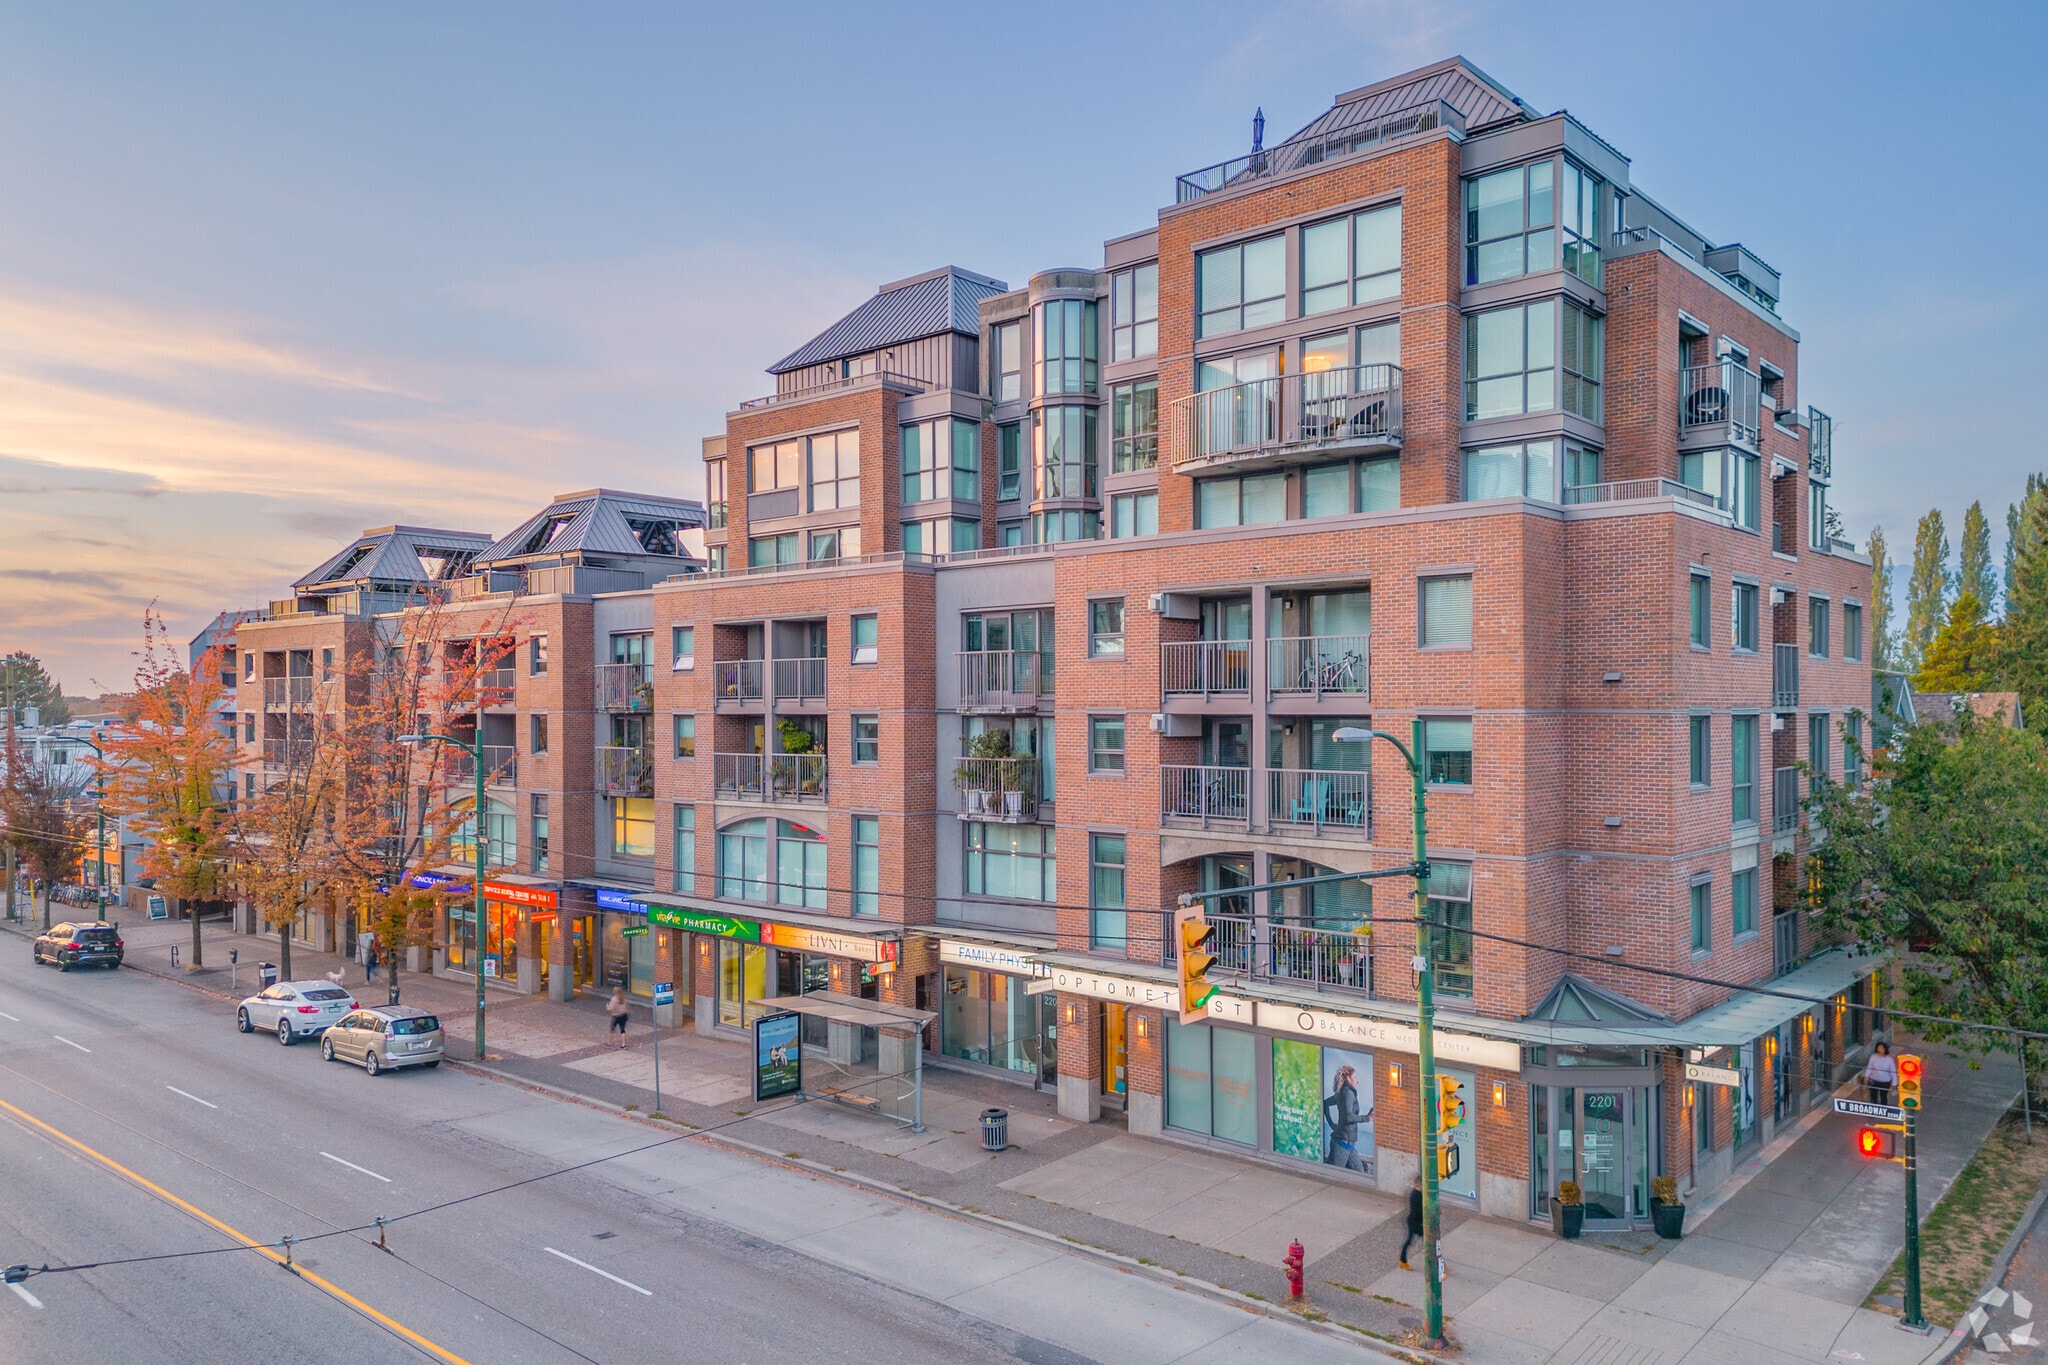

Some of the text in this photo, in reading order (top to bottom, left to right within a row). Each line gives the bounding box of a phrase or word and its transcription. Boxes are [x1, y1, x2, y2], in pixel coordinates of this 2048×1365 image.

[683, 917, 727, 932] PHARMACY
[809, 934, 842, 951] LIVNI
[958, 946, 997, 963] FAMILY
[1058, 974, 1242, 1016] OPTOMETST
[1320, 1019, 1471, 1053] BALANCE MEDI CENTER
[1701, 1071, 1737, 1081] BALANCE
[1589, 1095, 1617, 1108] 2201
[1840, 1102, 1846, 1110] W
[1849, 1103, 1888, 1116] BROADWAY
[1278, 1104, 1306, 1116] Your best
